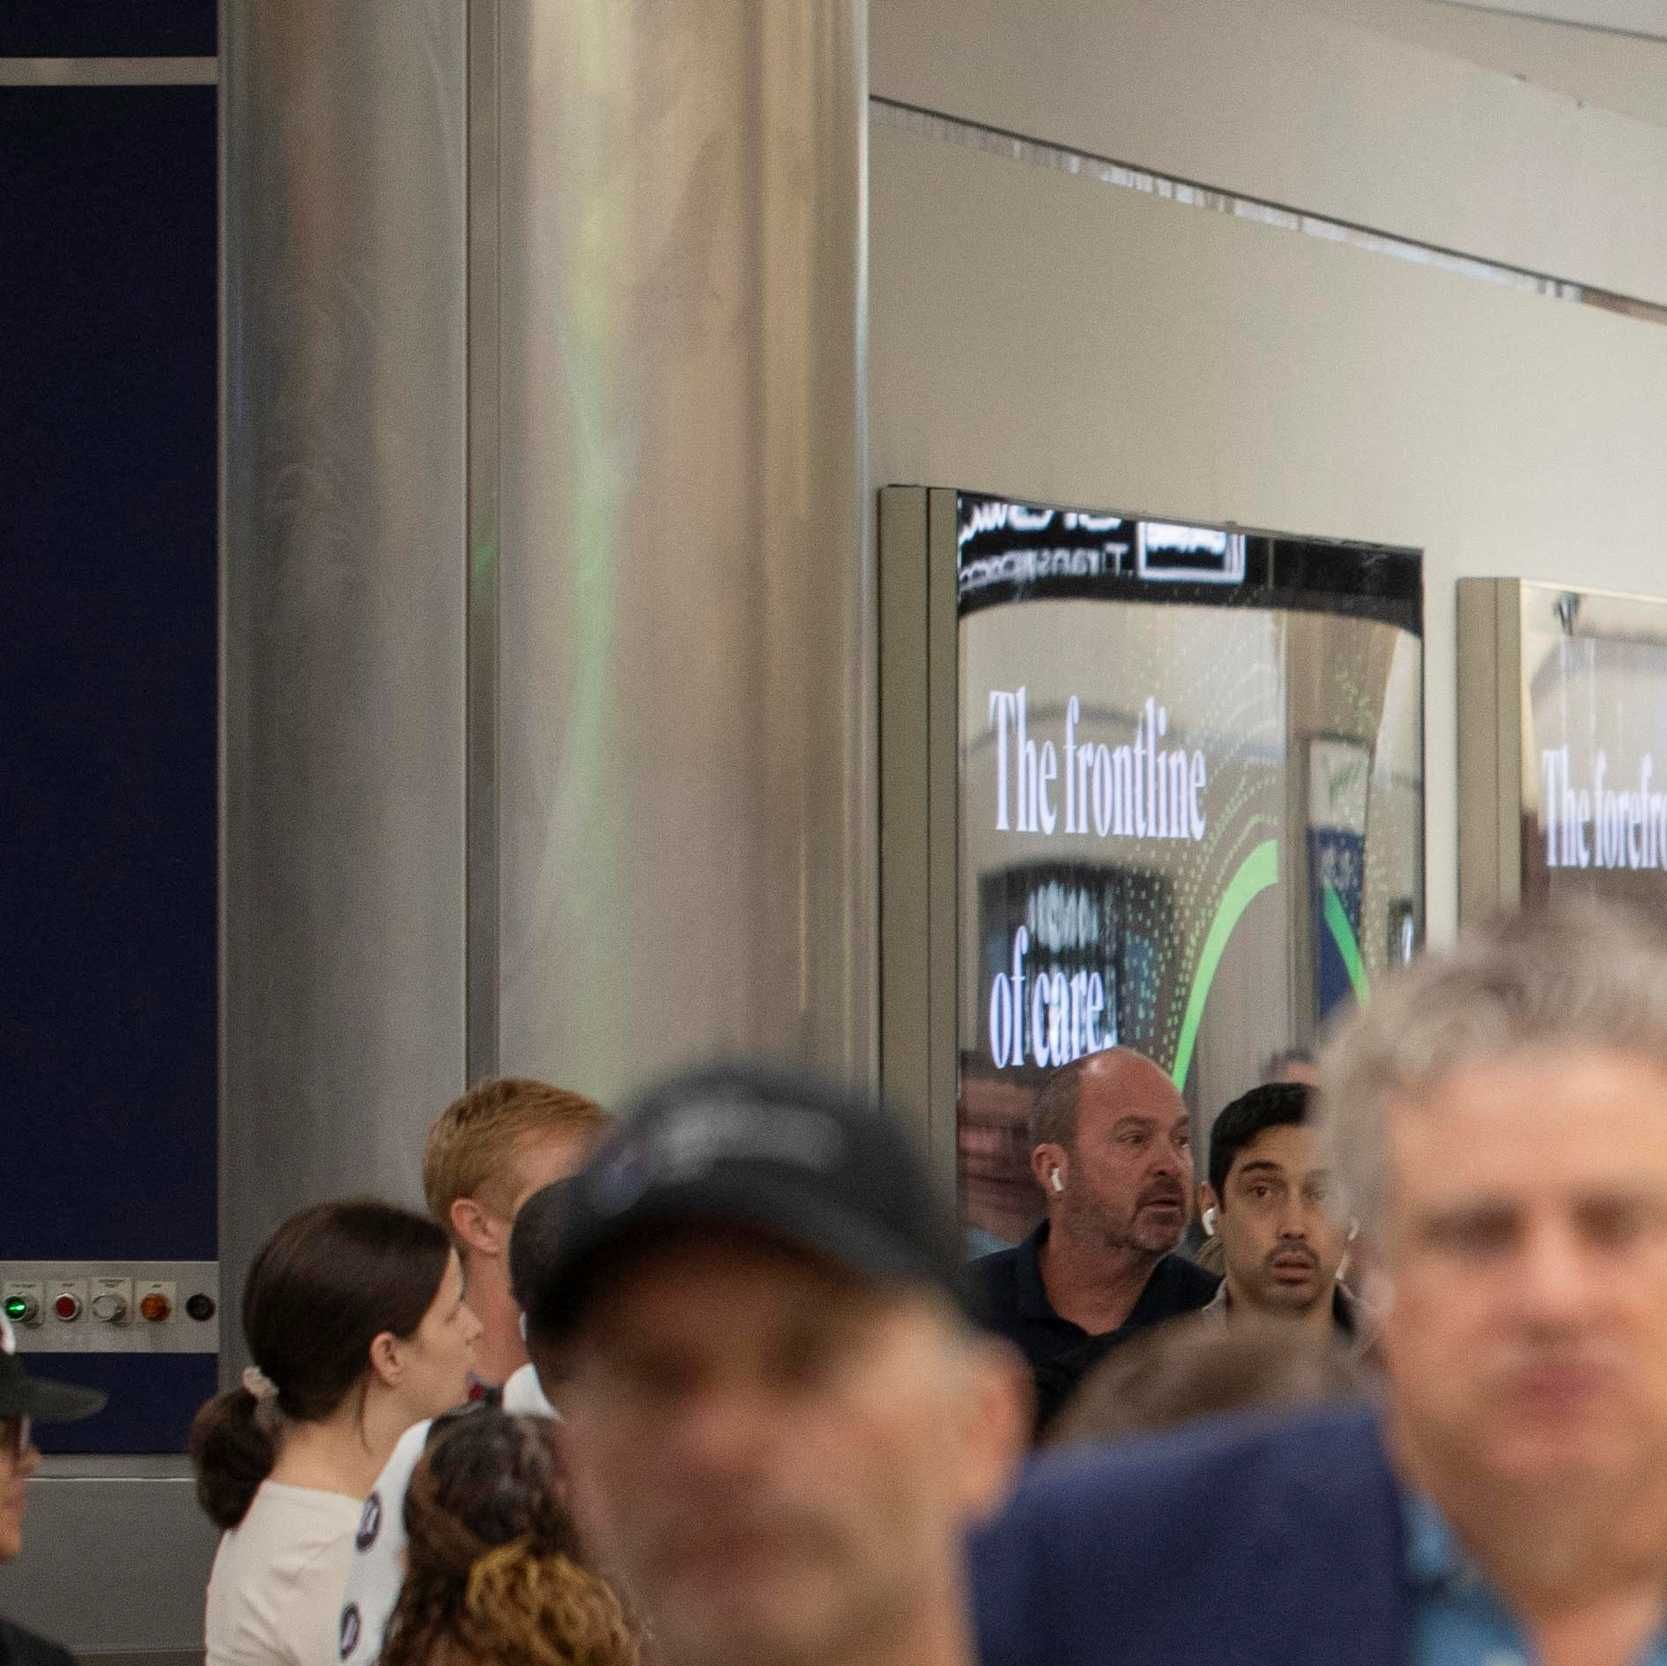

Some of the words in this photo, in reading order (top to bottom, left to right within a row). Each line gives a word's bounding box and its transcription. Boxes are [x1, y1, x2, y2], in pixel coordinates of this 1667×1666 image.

[988, 686, 1058, 836] The
[1063, 695, 1208, 842] frontline
[1541, 745, 1590, 869] The
[989, 926, 1029, 1069] of
